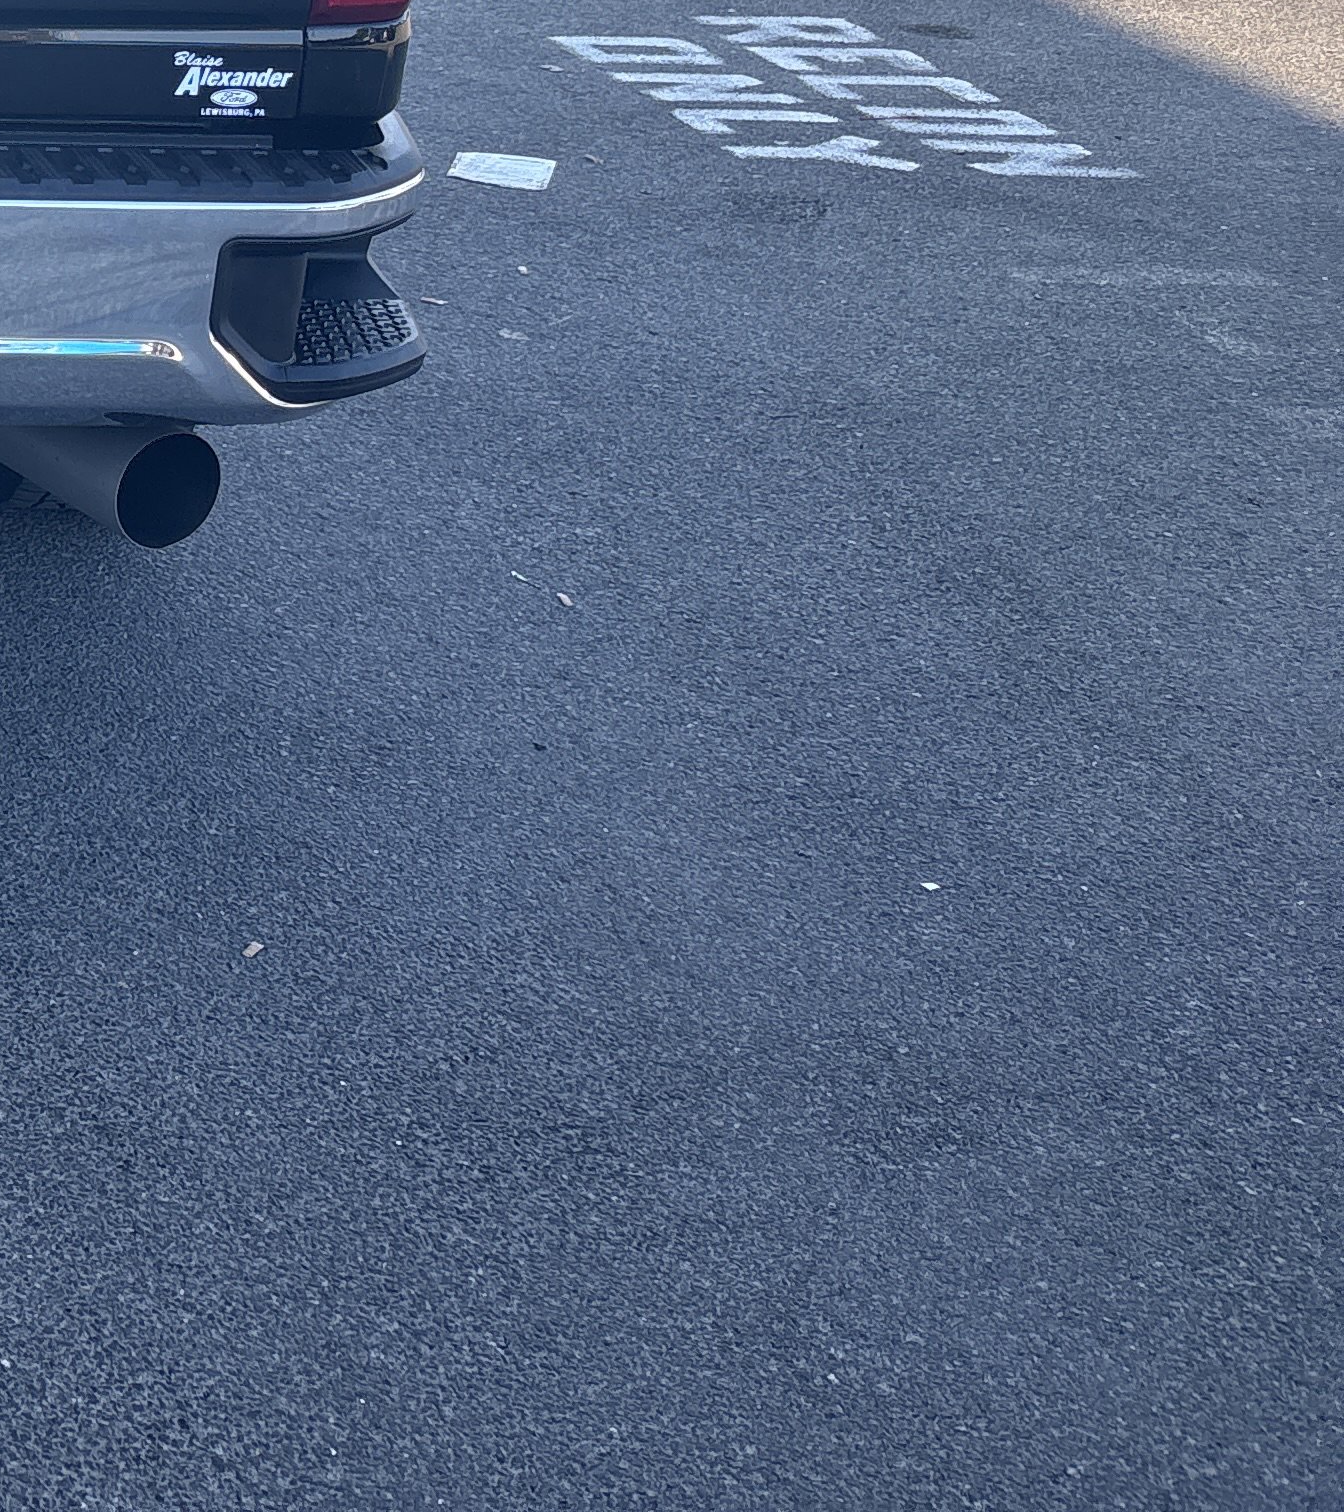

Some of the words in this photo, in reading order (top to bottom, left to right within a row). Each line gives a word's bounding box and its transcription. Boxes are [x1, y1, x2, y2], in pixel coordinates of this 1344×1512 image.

[174, 51, 224, 67] Blaise
[174, 67, 294, 96] Alexander
[548, 35, 920, 172] ONLY
[691, 16, 1146, 178] RECON
[254, 108, 266, 117] PA
